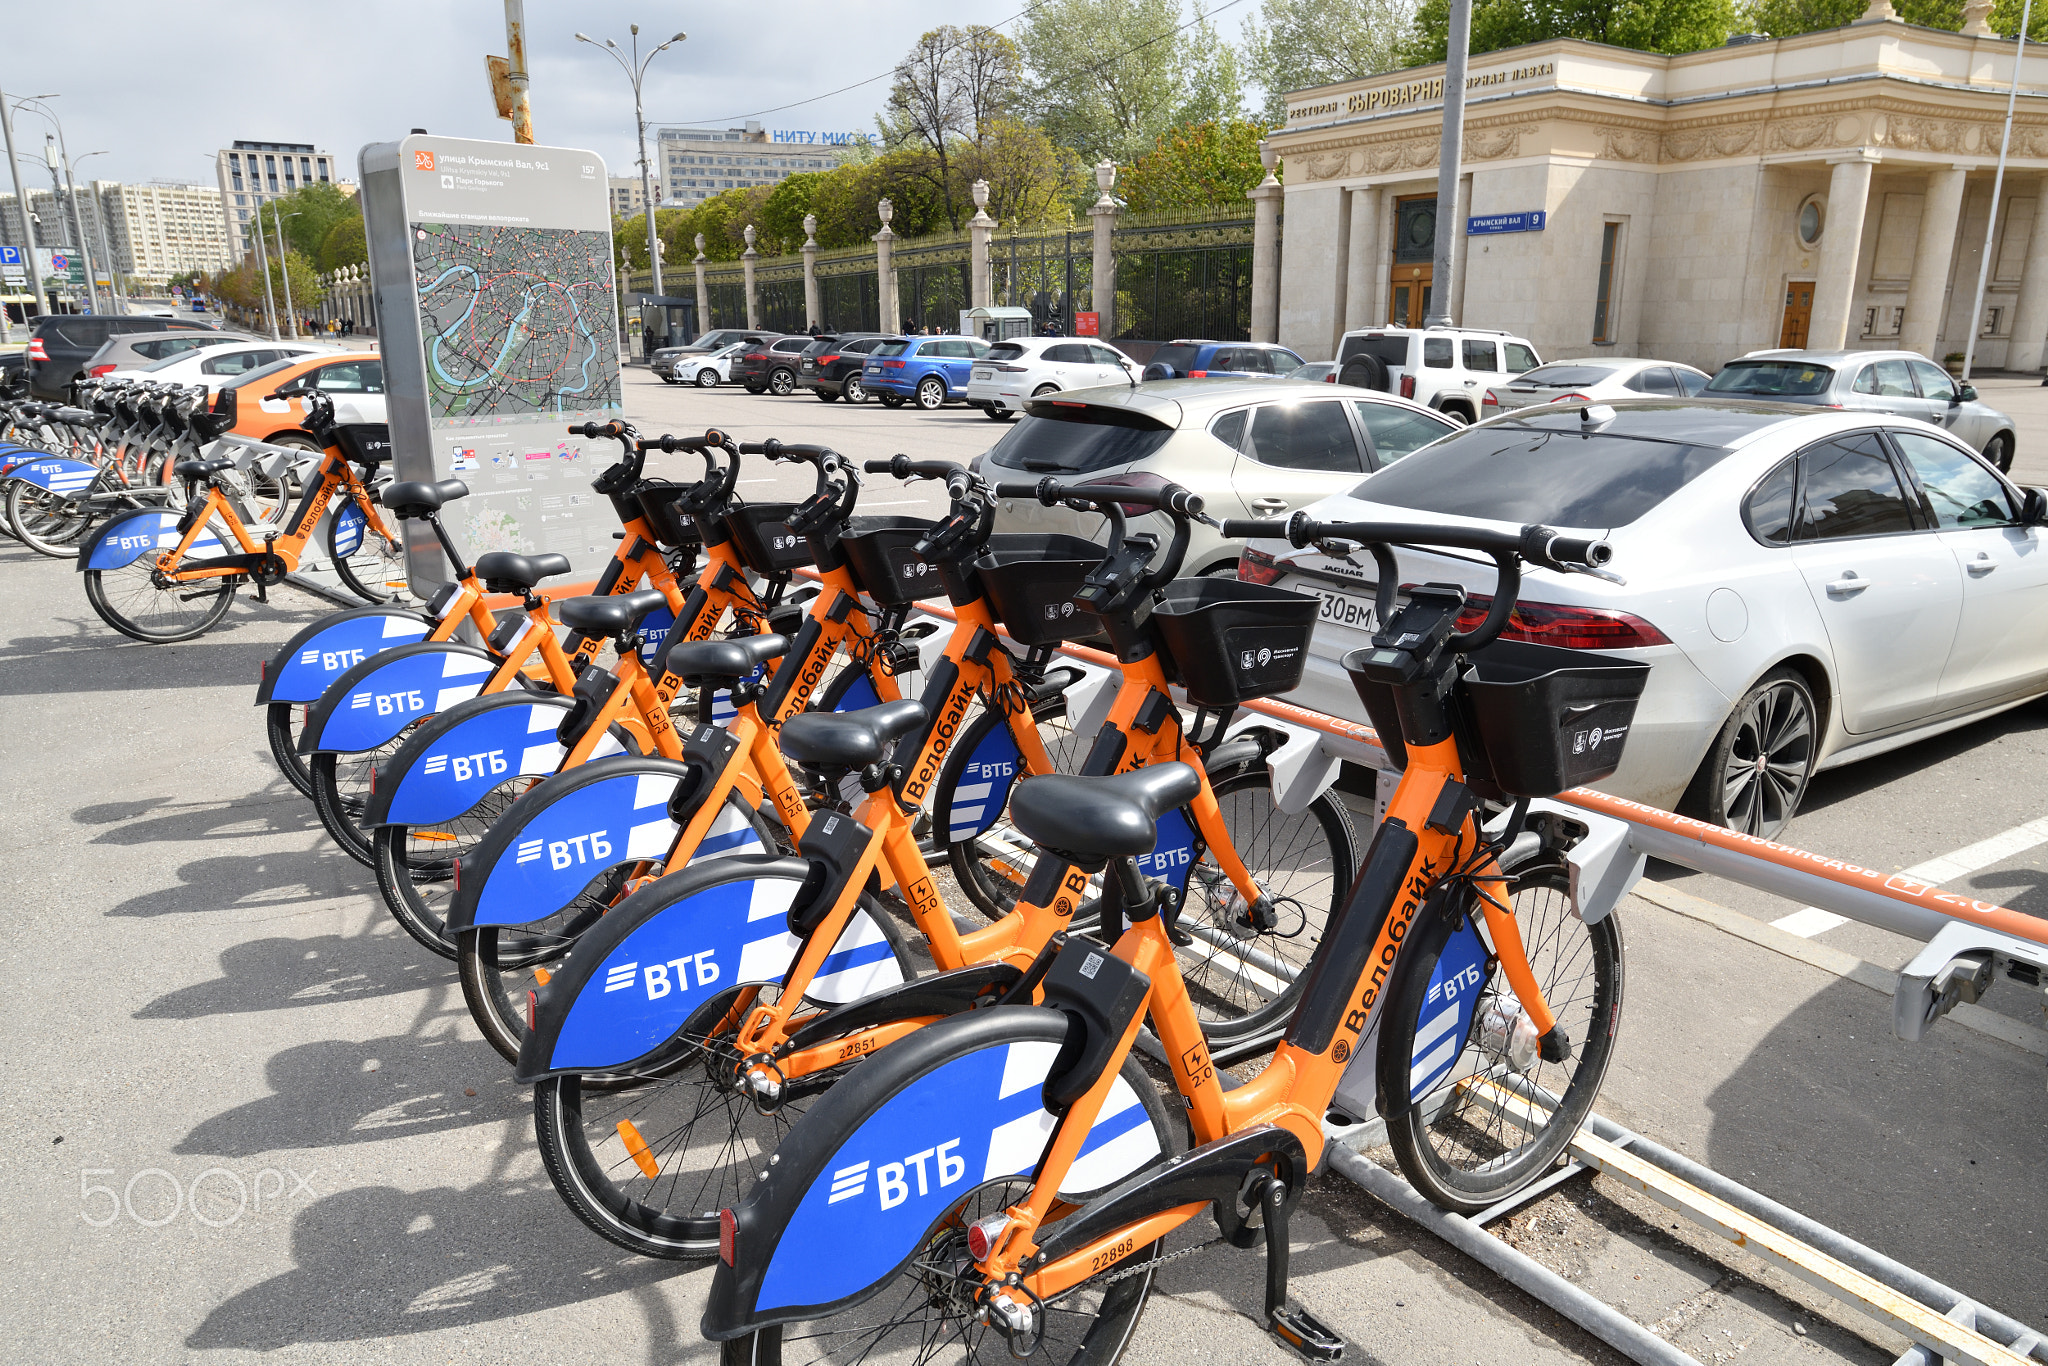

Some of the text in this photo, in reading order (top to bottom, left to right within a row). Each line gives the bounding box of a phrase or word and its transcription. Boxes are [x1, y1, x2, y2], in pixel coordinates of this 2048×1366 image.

[1290, 63, 1553, 118] РЕСТОРАН СЫРОВАРНЯ ЫРНАЯ ЛАВКА
[773, 130, 877, 146] НИТУ МИСС
[439, 154, 466, 165] улица
[468, 155, 514, 168] Крымский
[515, 159, 534, 171] Вал,
[582, 165, 595, 174] 157
[455, 176, 504, 187] Парк Горького
[1473, 216, 1521, 227] КРЫМСКИЙ ВАЛ
[1532, 214, 1539, 225] 9
[40, 464, 63, 475] ВТБ
[300, 480, 336, 533] Велобайк
[346, 516, 364, 528] ВТБ
[120, 534, 151, 550] ВТБ
[1321, 564, 1364, 578] JAGUAR
[322, 648, 366, 671] ВТБ
[375, 690, 425, 716] ВТБ
[654, 722, 670, 734] 2.0
[906, 680, 975, 800] Велобайк
[452, 749, 508, 782] ВТБ
[981, 761, 1013, 779] ВТБ
[787, 803, 803, 818] 2.0
[548, 829, 612, 871] ВТБ
[1154, 846, 1190, 871] ВТБ
[918, 897, 938, 916] 2.0
[1344, 855, 1437, 1035] Велобайк
[643, 949, 720, 1000] ВТБ
[1443, 963, 1480, 1001] ВТБ
[839, 1037, 876, 1060] 22851
[1191, 1066, 1213, 1088] 2.0
[876, 1137, 966, 1211] ВТБ
[1091, 1238, 1134, 1273] 22898
